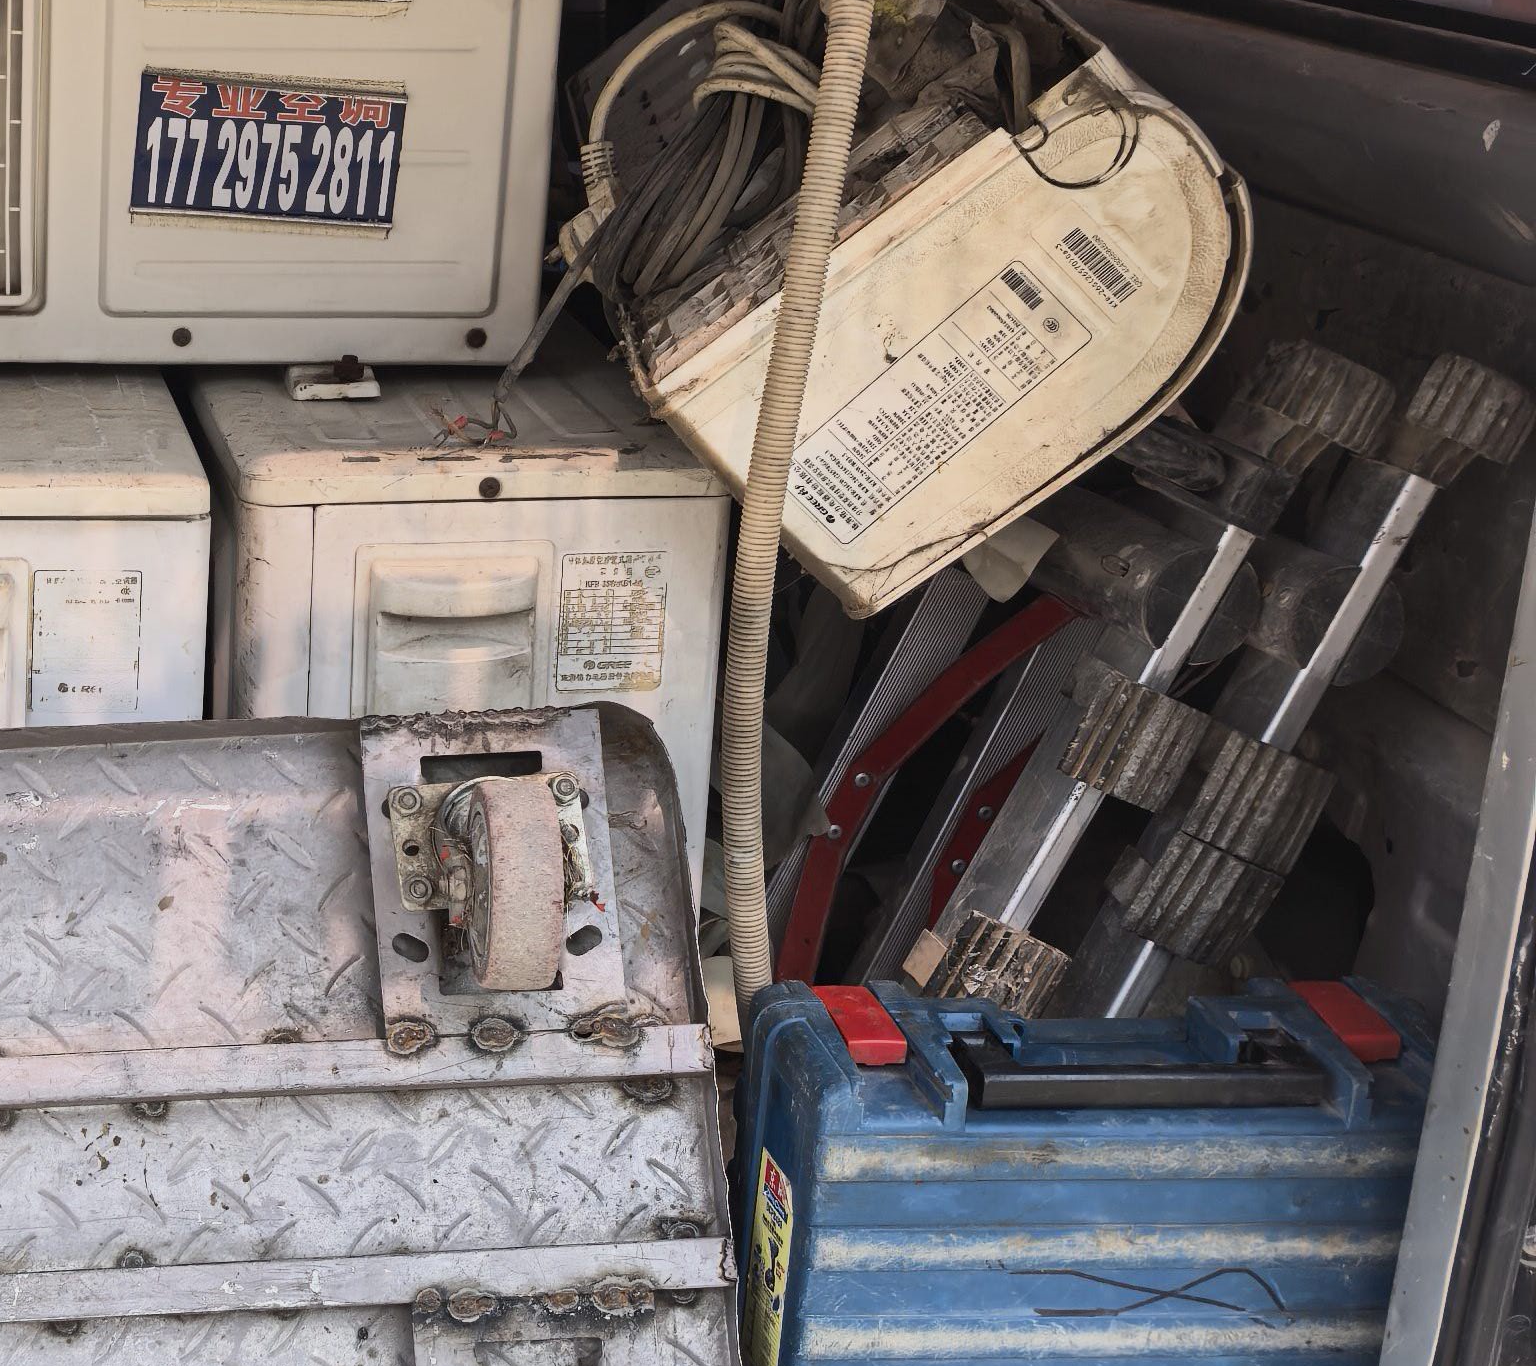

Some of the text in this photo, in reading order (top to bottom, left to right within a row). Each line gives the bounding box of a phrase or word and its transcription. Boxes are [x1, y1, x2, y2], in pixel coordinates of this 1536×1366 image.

[146, 117, 395, 216] 177 2975 2811
[805, 492, 829, 517] GREE
